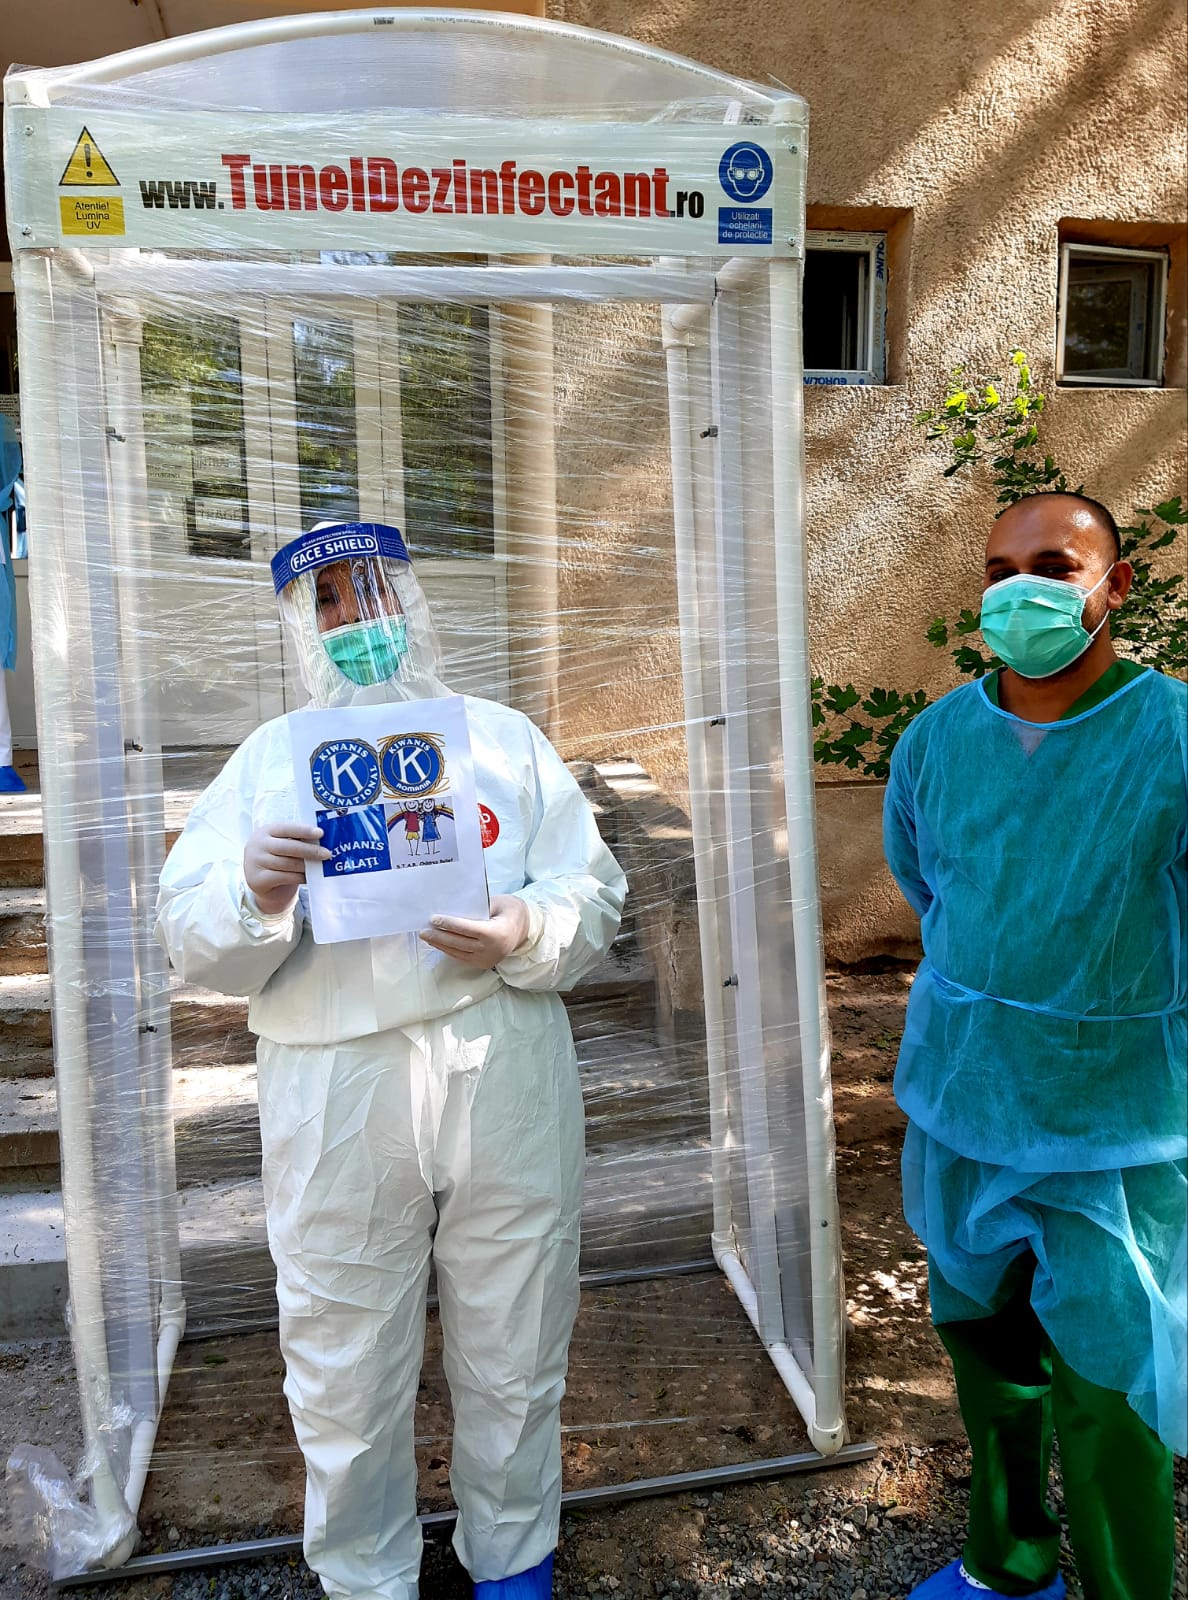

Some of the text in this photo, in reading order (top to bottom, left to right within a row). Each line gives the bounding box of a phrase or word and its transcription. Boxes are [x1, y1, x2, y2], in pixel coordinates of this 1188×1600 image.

[76, 211, 110, 220] Lumina
[86, 221, 101, 230] UV
[722, 230, 733, 238] de
[803, 376, 847, 385] EUROLIN
[293, 547, 323, 569] FACE
[324, 537, 375, 554] SHIELD
[319, 743, 369, 761] KIWANIS
[388, 739, 432, 754] KIWANIS
[313, 765, 378, 806] INTERNATIONAL
